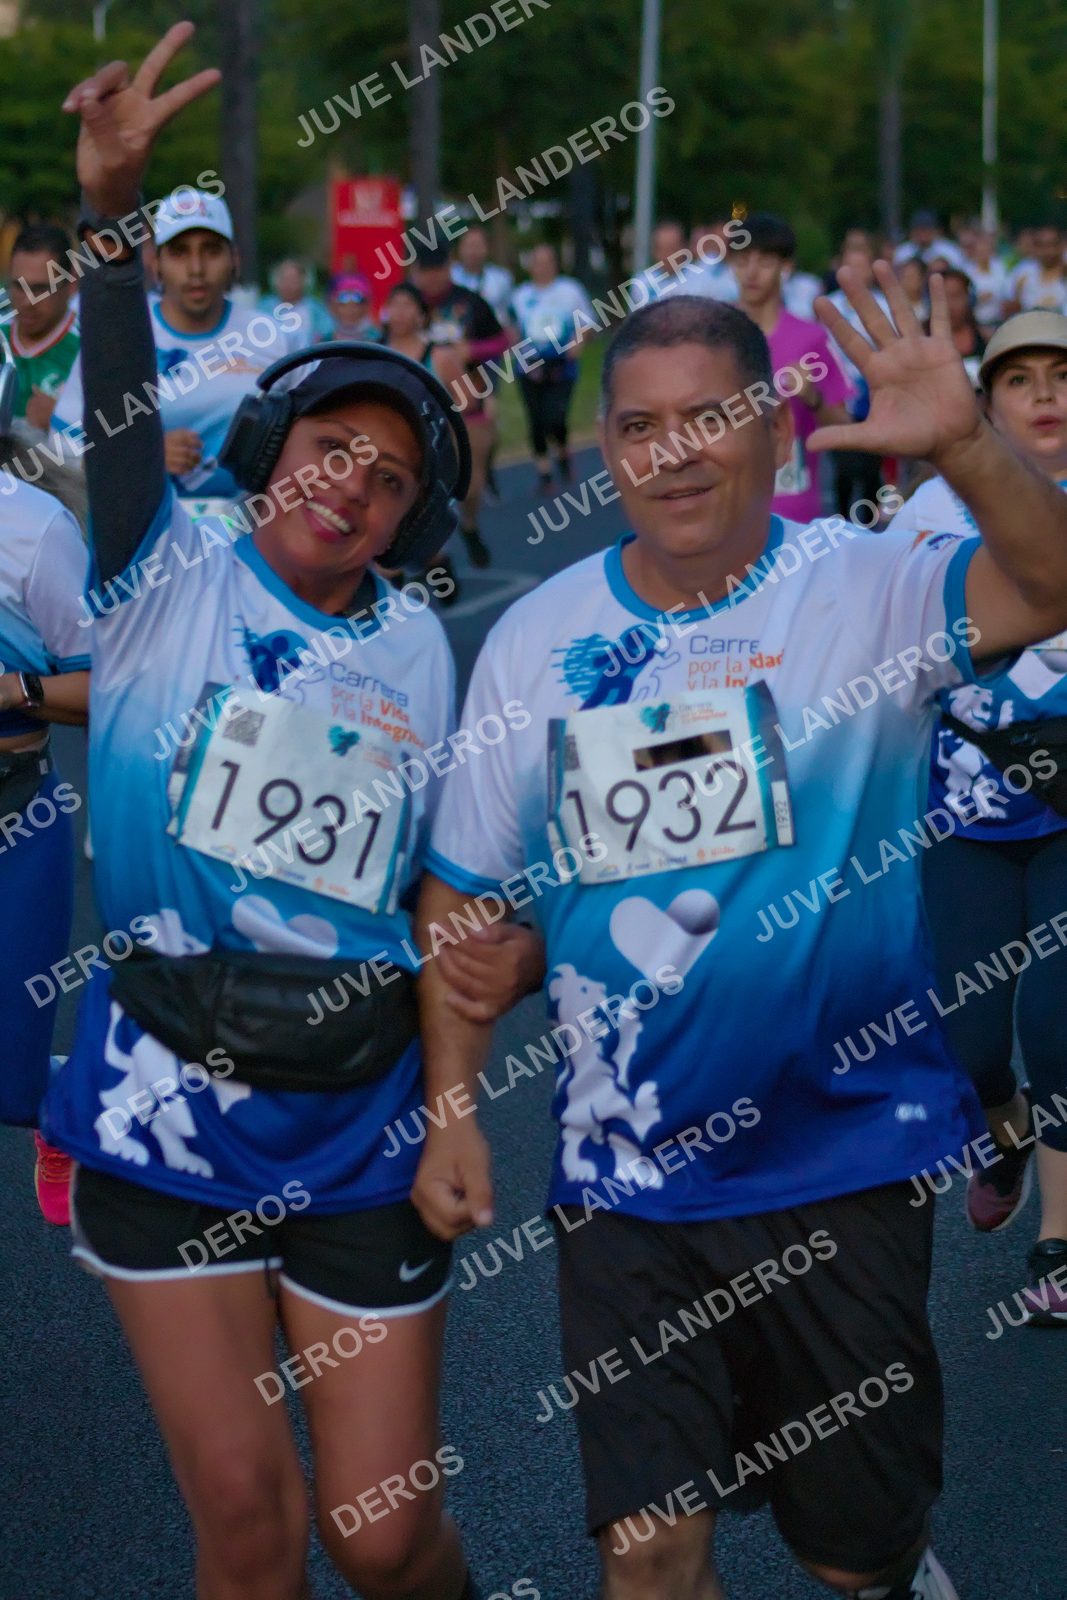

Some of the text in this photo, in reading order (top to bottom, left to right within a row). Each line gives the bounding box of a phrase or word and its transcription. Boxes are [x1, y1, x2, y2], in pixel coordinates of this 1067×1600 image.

[688, 659, 720, 679] por
[726, 656, 743, 673] la
[703, 675, 719, 689] la
[211, 760, 382, 880] 1931
[566, 760, 757, 858] 1932
[775, 799, 789, 830] 1932
